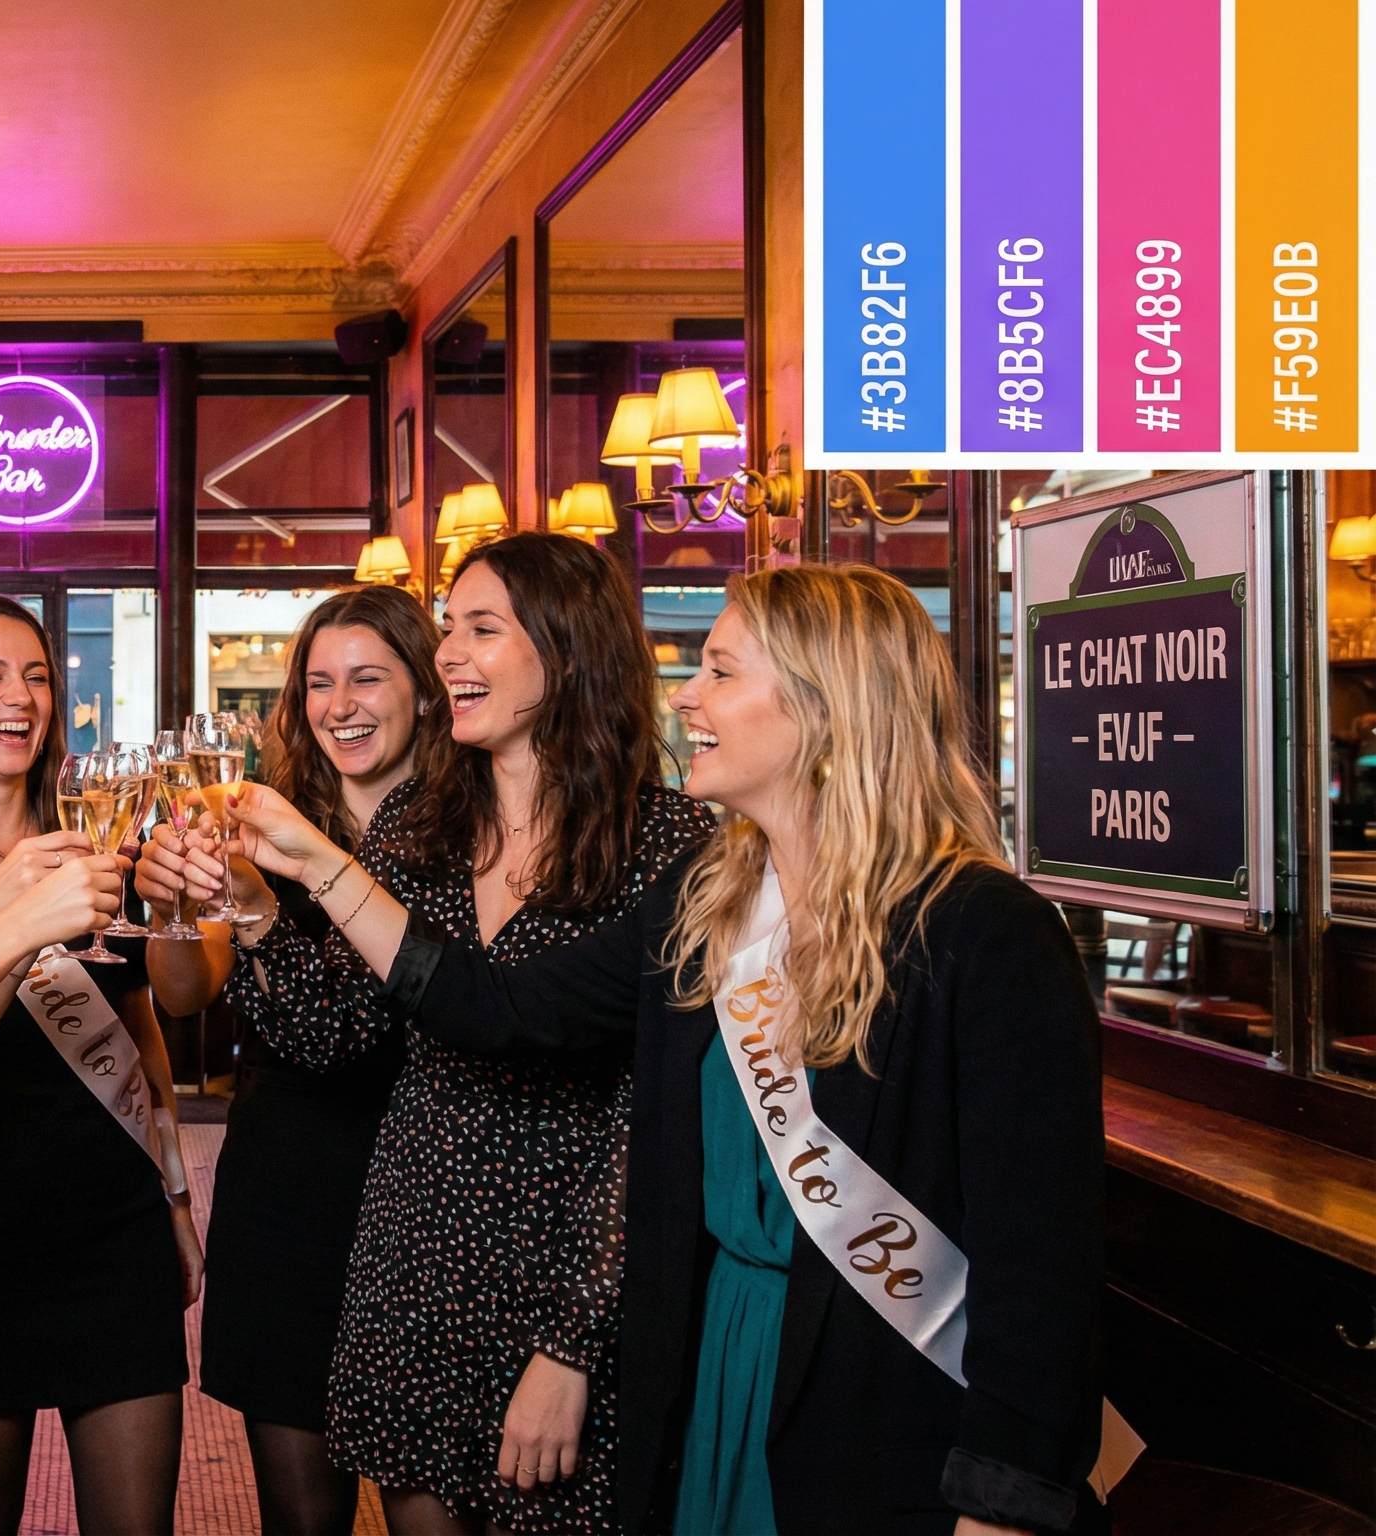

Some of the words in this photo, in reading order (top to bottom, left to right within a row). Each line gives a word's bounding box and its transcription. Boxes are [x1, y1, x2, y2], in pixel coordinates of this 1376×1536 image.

[1044, 643, 1072, 690] LE
[1080, 635, 1147, 688] CHAT
[1155, 627, 1227, 683] NOIR
[1098, 711, 1163, 762] EVJF
[1091, 788, 1171, 843] PARIS
[80, 1032, 119, 1077] to
[727, 965, 797, 1137] Bride
[788, 1139, 843, 1208] to
[846, 1212, 923, 1300] Be
